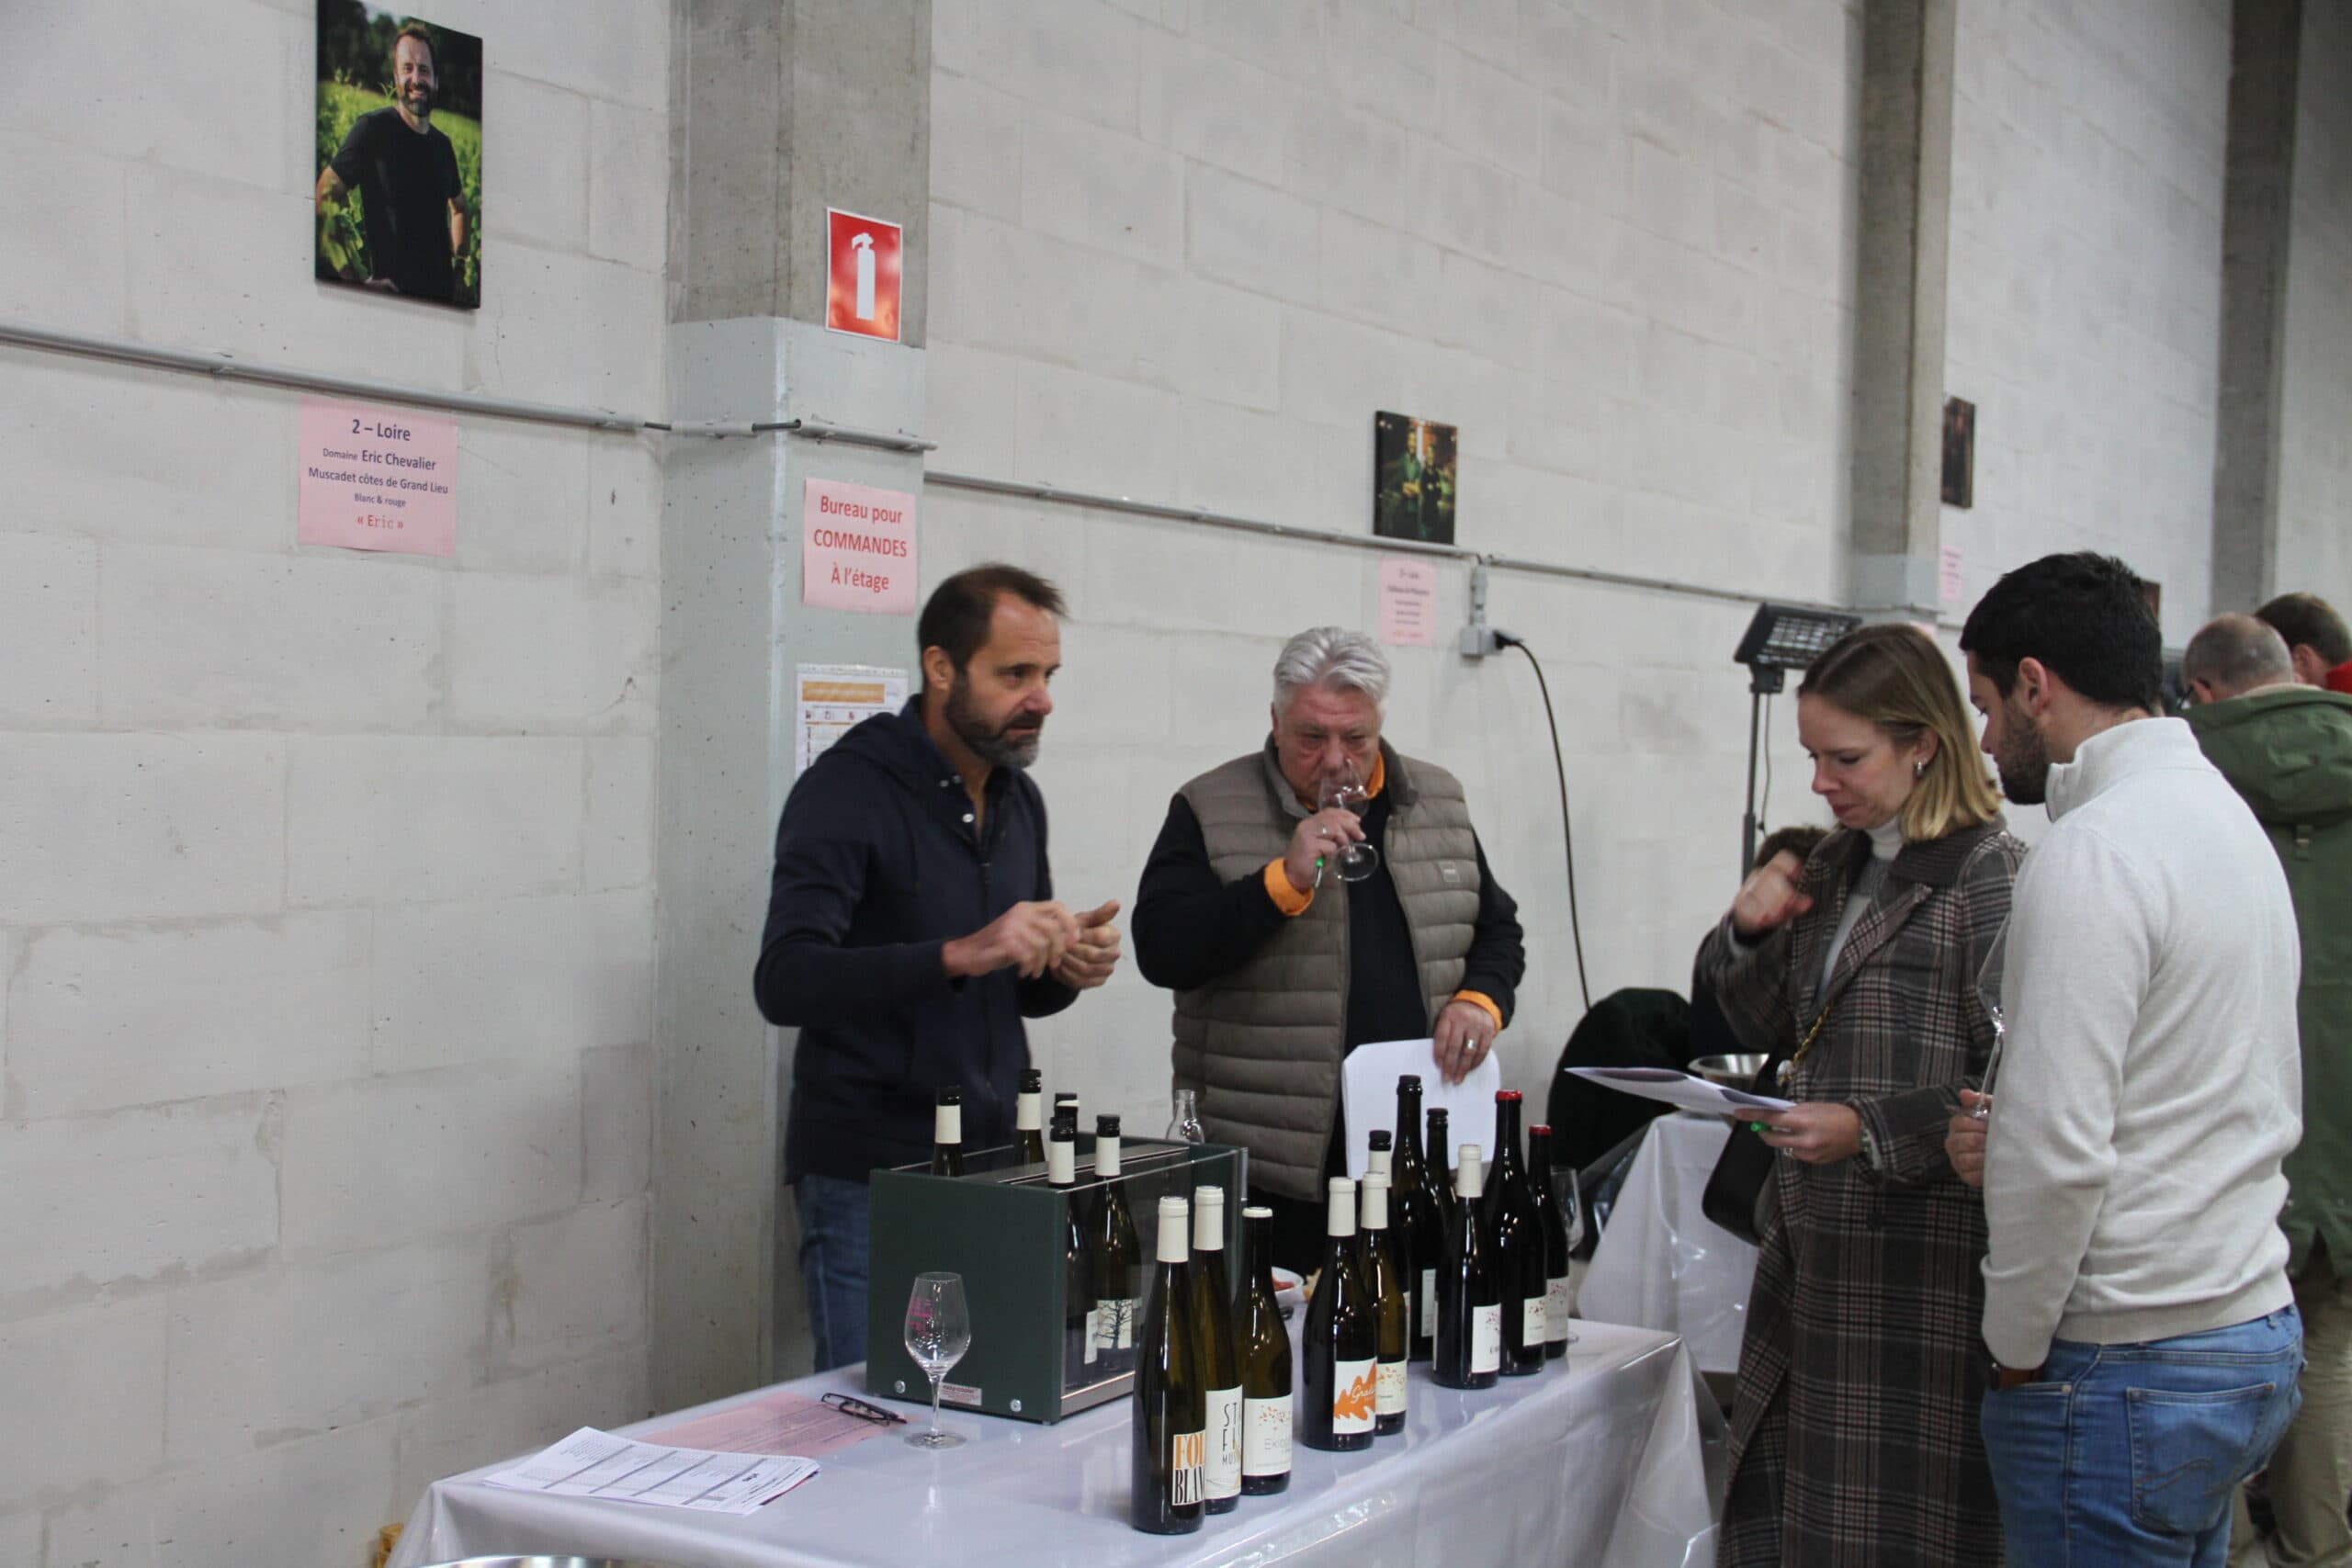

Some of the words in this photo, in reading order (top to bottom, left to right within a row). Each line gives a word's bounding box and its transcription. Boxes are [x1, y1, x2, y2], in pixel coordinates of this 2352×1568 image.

[351, 419, 361, 434] 2
[377, 423, 411, 441] Loire
[322, 448, 358, 461] Domaine
[362, 450, 383, 464] Eric
[385, 453, 436, 470] Chevalier
[309, 467, 356, 483] Muscadet
[358, 472, 384, 487] côtes
[386, 477, 398, 488] de
[400, 479, 428, 491] Grand
[430, 482, 448, 494] Lieu
[354, 493, 375, 504] Blanc
[377, 496, 384, 504] &
[384, 499, 406, 508] rouge
[820, 495, 868, 519] Bureau
[872, 507, 903, 525] pour
[368, 514, 394, 529] Eric
[813, 528, 908, 558] COMMANDES
[831, 561, 841, 584] À
[844, 567, 889, 593] l'étage
